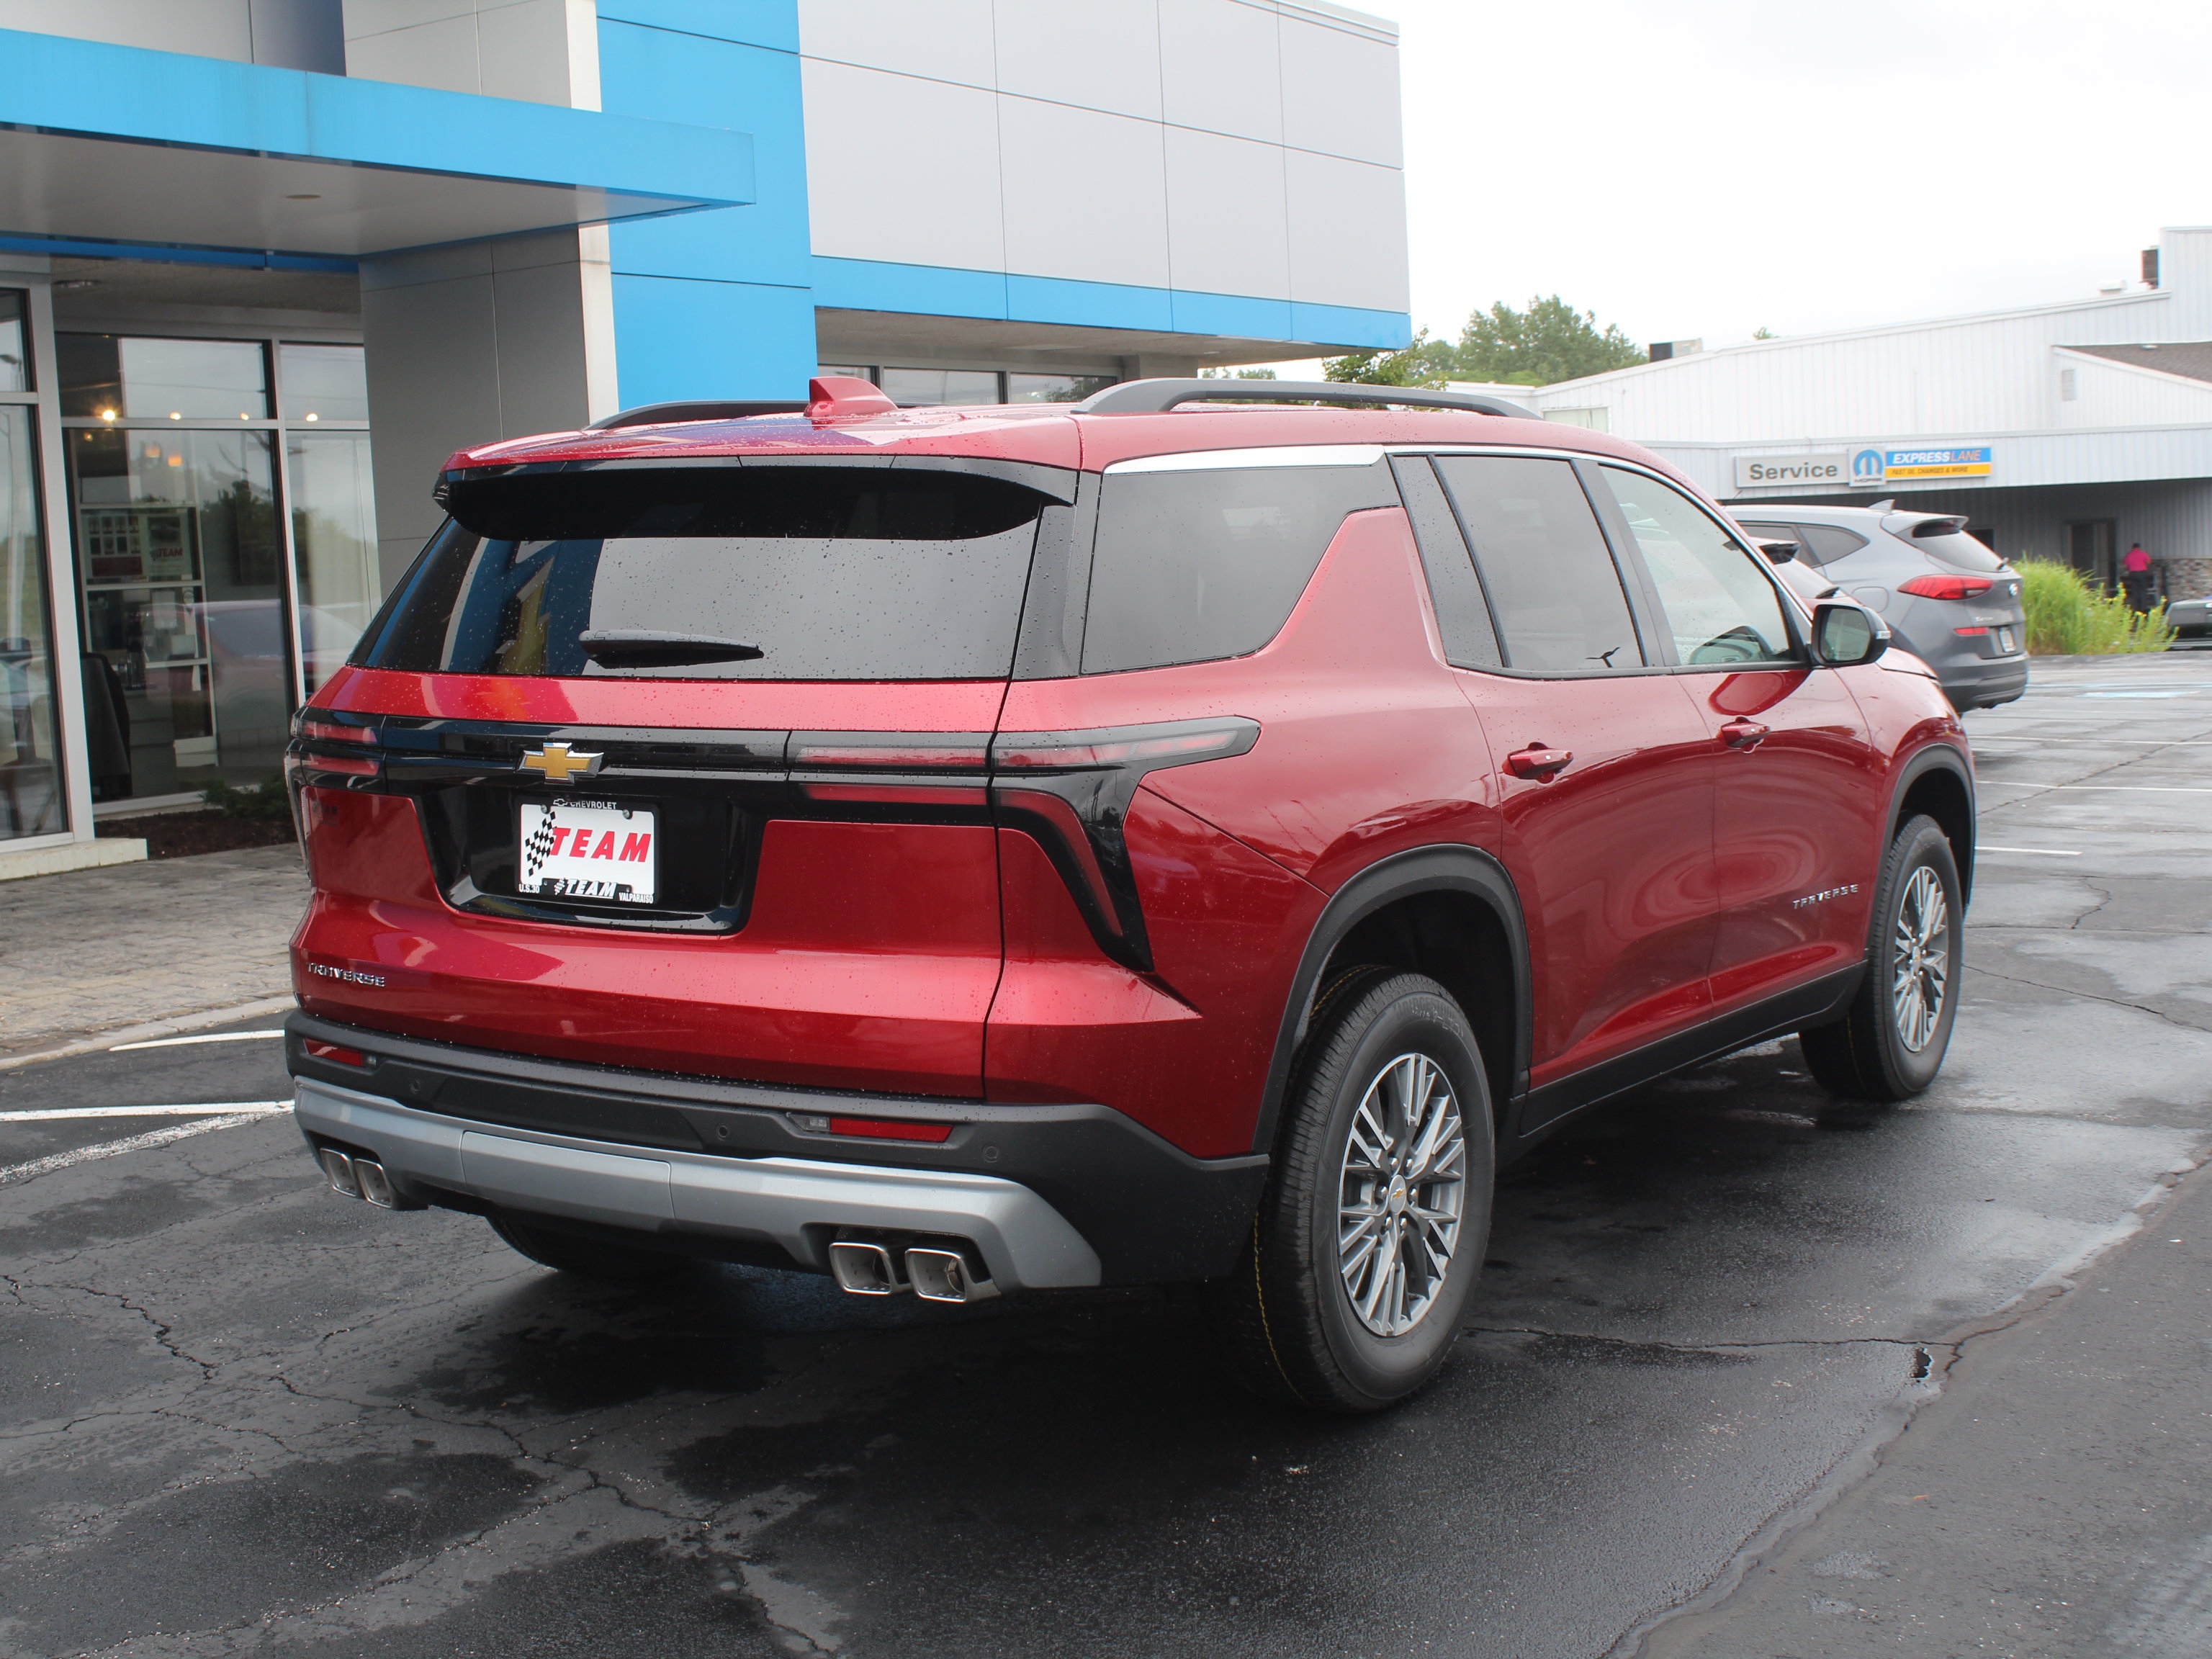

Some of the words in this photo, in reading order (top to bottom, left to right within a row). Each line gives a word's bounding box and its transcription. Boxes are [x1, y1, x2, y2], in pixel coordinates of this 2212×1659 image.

[1750, 462, 1838, 480] Service
[158, 547, 182, 557] TEAM
[570, 800, 617, 810] CHEVROLET
[550, 827, 651, 863] TEAM
[565, 878, 616, 898] TEAM
[1792, 884, 1858, 909] TRAVERSE
[619, 892, 653, 904] VALPARAISO
[307, 963, 385, 986] TRAVERSE
